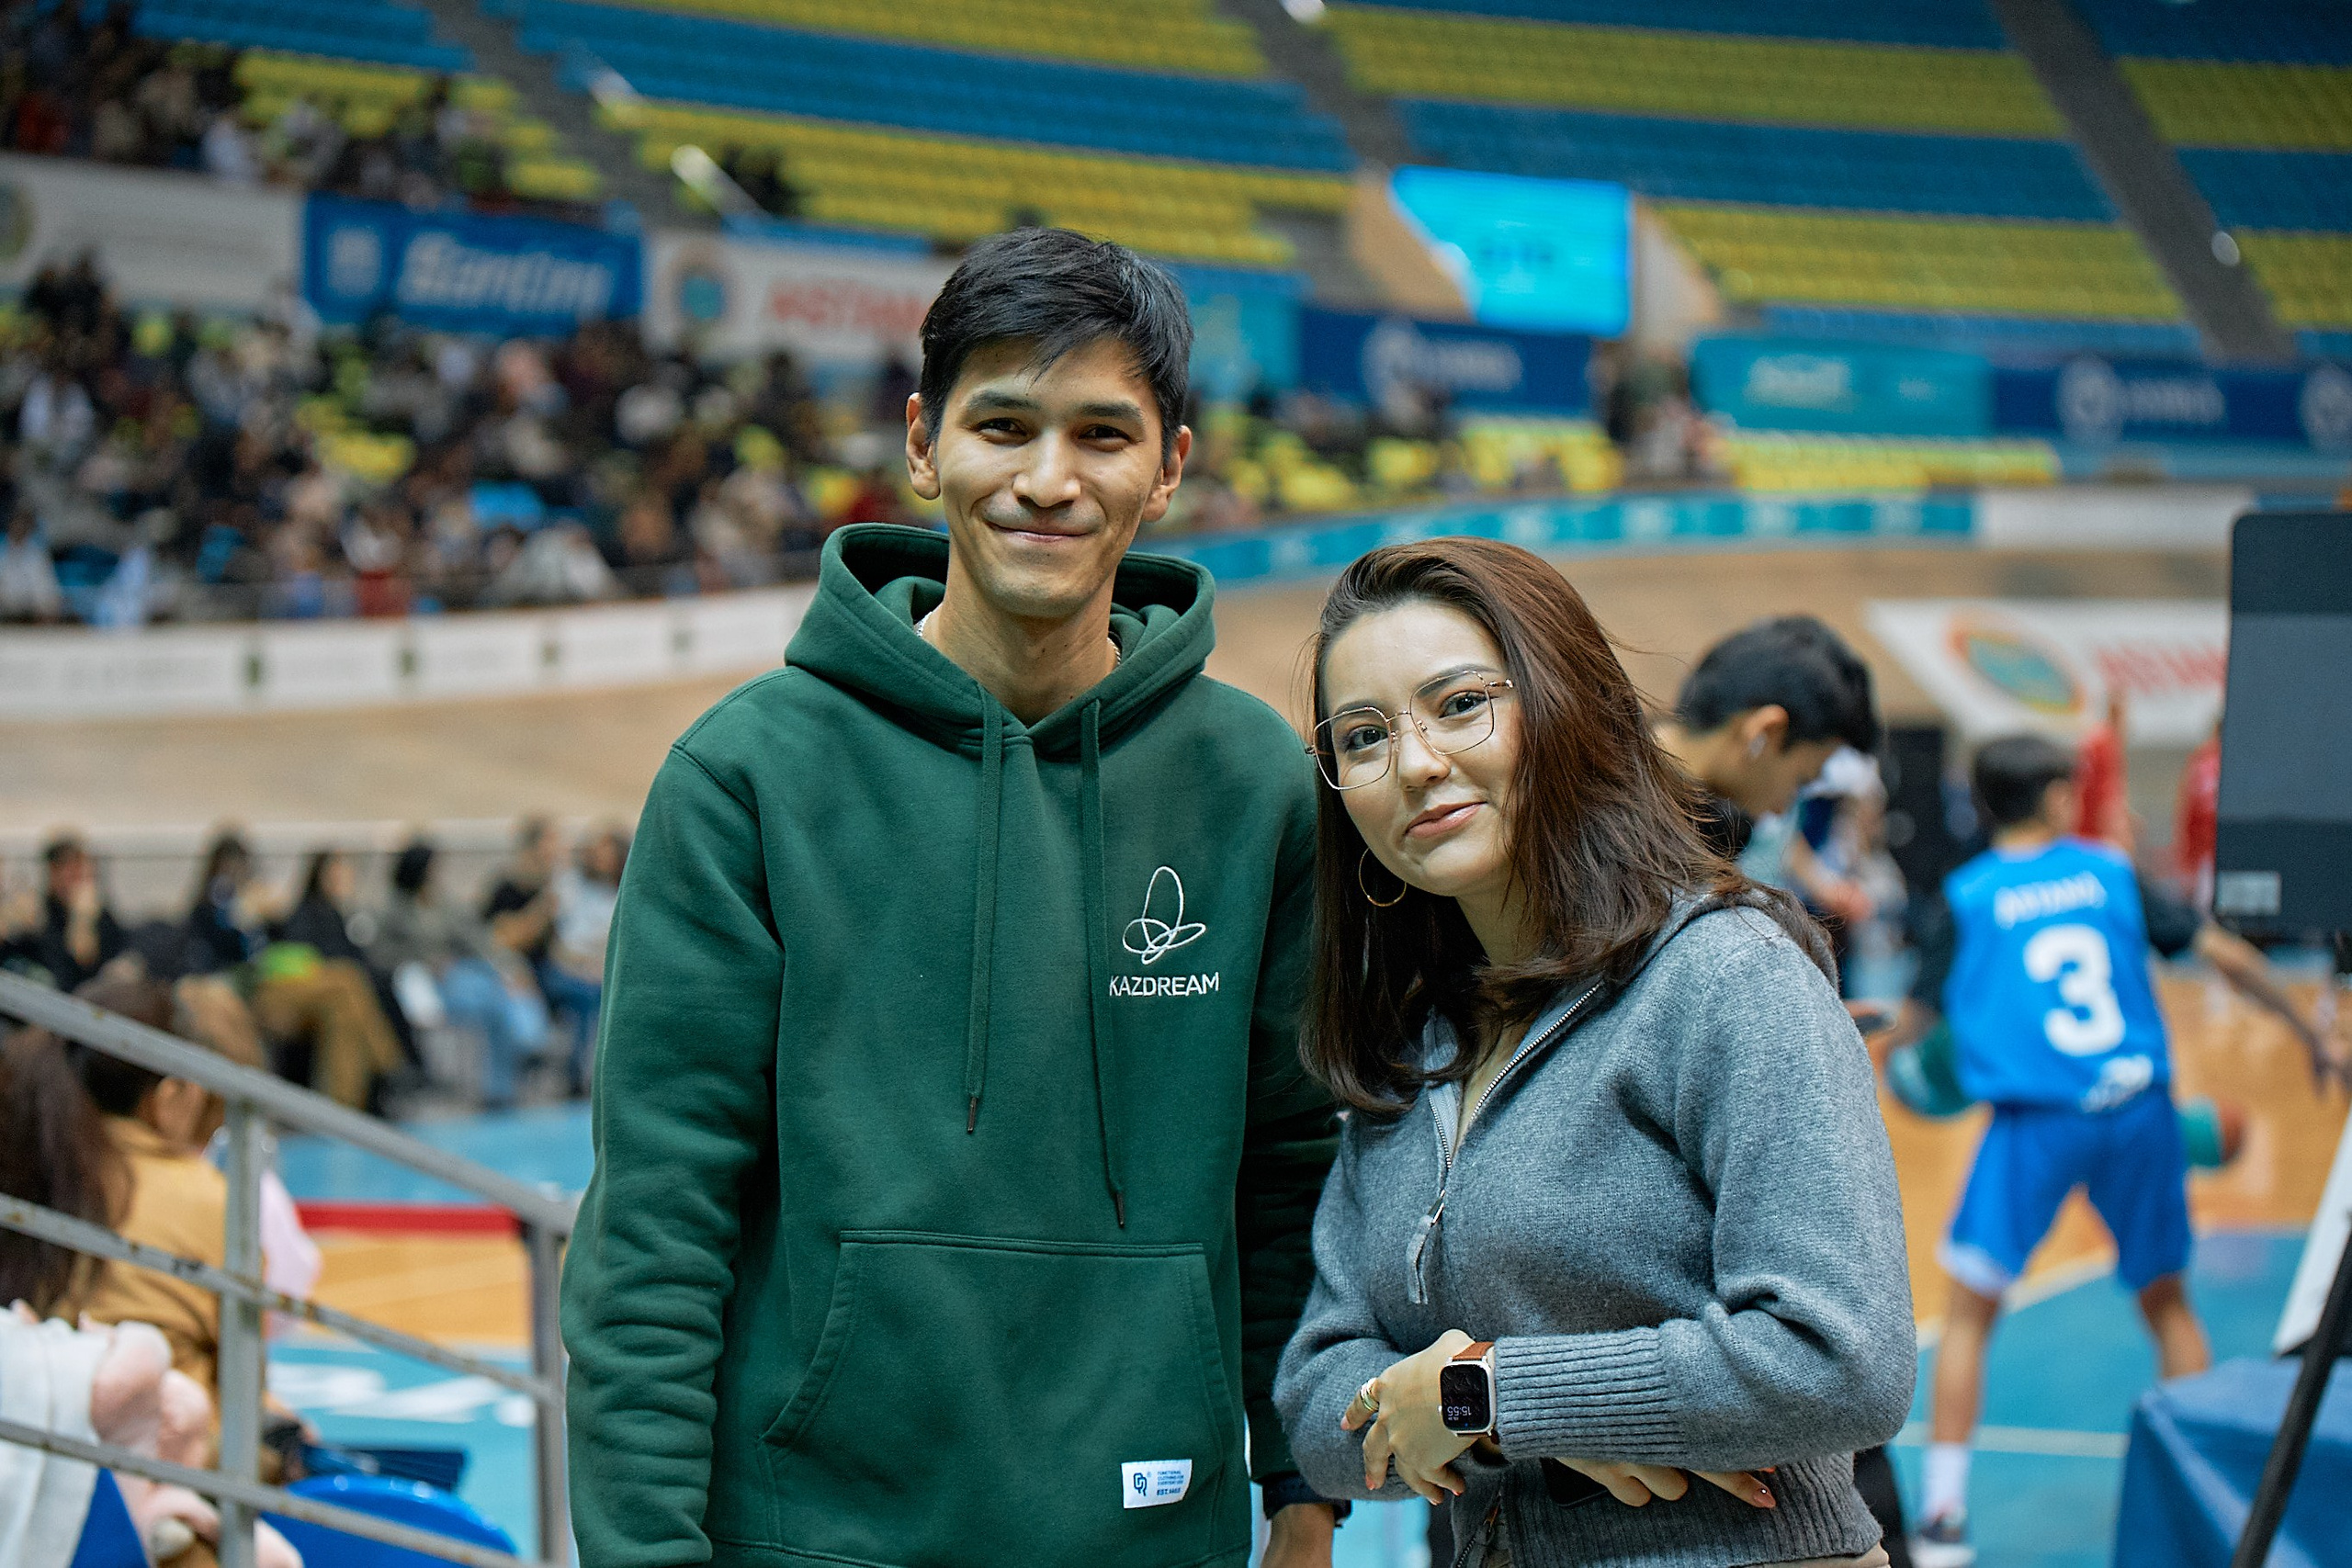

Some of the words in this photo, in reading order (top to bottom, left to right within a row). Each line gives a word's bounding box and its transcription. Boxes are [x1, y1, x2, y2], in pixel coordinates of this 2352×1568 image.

[1109, 972, 1219, 997] KAZDREAM
[2023, 923, 2126, 1056] 3
[1447, 1405, 1472, 1416] 15:55
